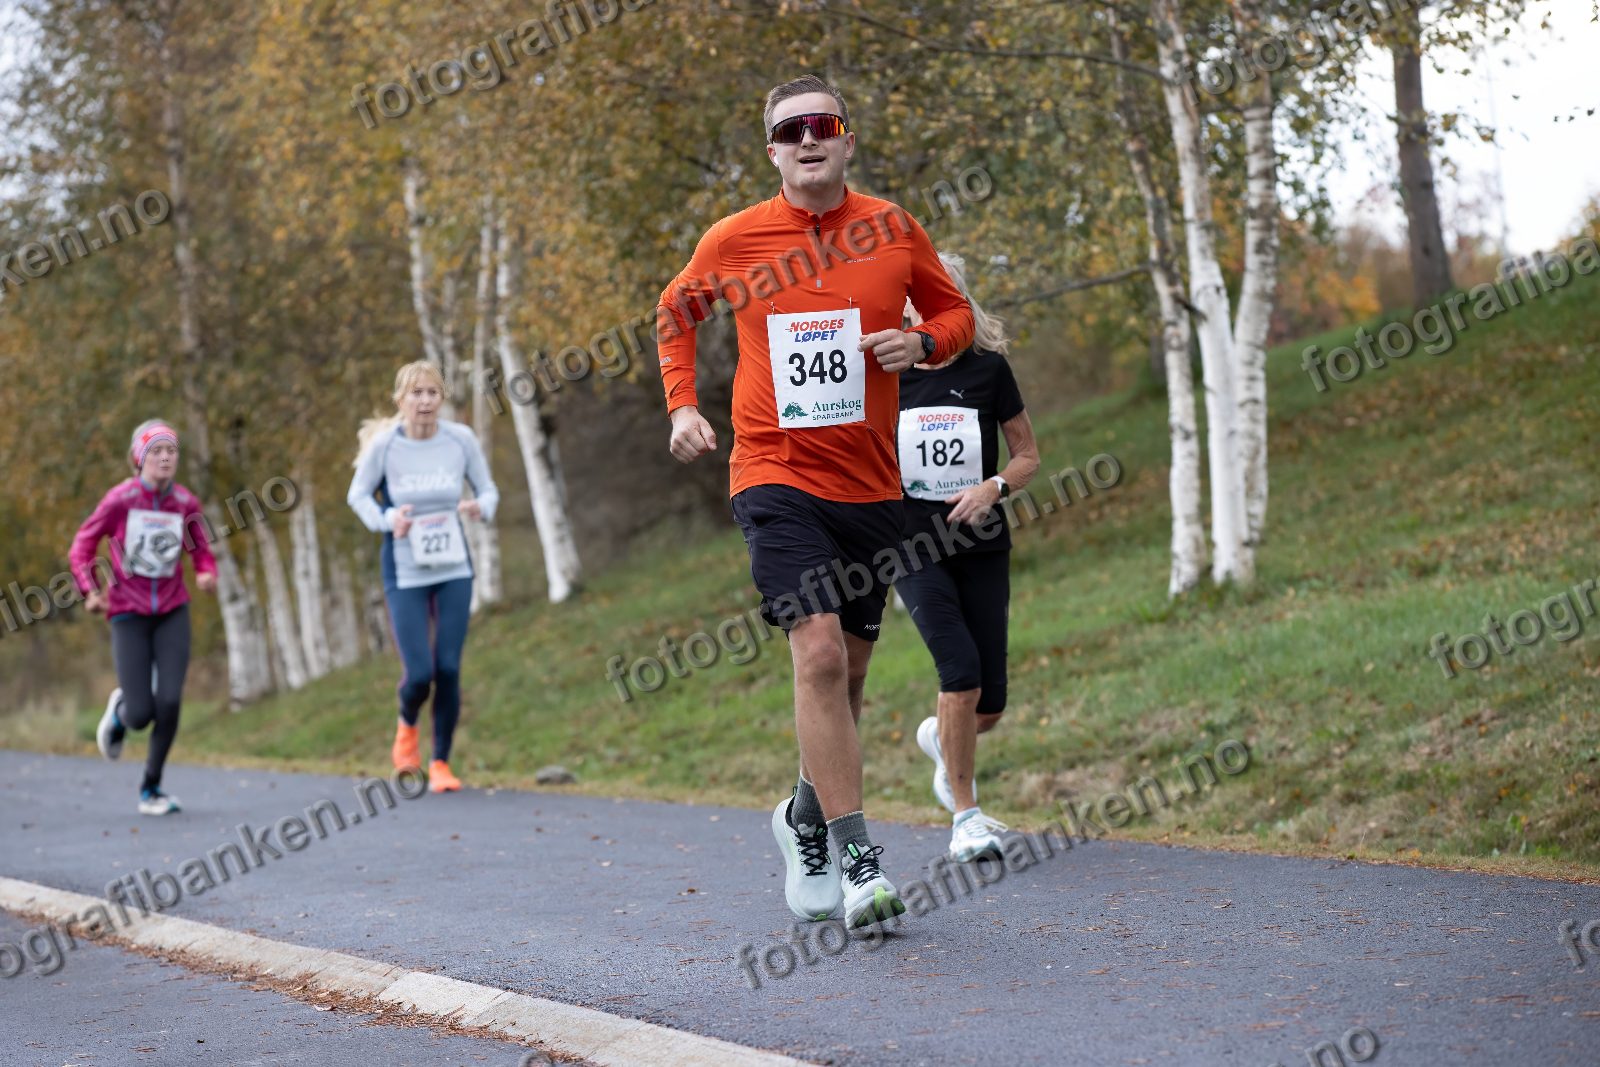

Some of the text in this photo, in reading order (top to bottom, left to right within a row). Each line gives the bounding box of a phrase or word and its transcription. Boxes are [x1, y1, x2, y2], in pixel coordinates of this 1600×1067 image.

[786, 319, 845, 333] NORGES
[794, 330, 838, 343] LØPET
[788, 349, 848, 387] 348
[812, 398, 862, 413] Aurskog
[812, 410, 854, 421] SPAREBANK
[917, 414, 965, 423] NORGES
[921, 422, 957, 432] LØPET
[916, 438, 965, 467] 182
[935, 476, 980, 490] Aurskog
[421, 532, 450, 554] 227
